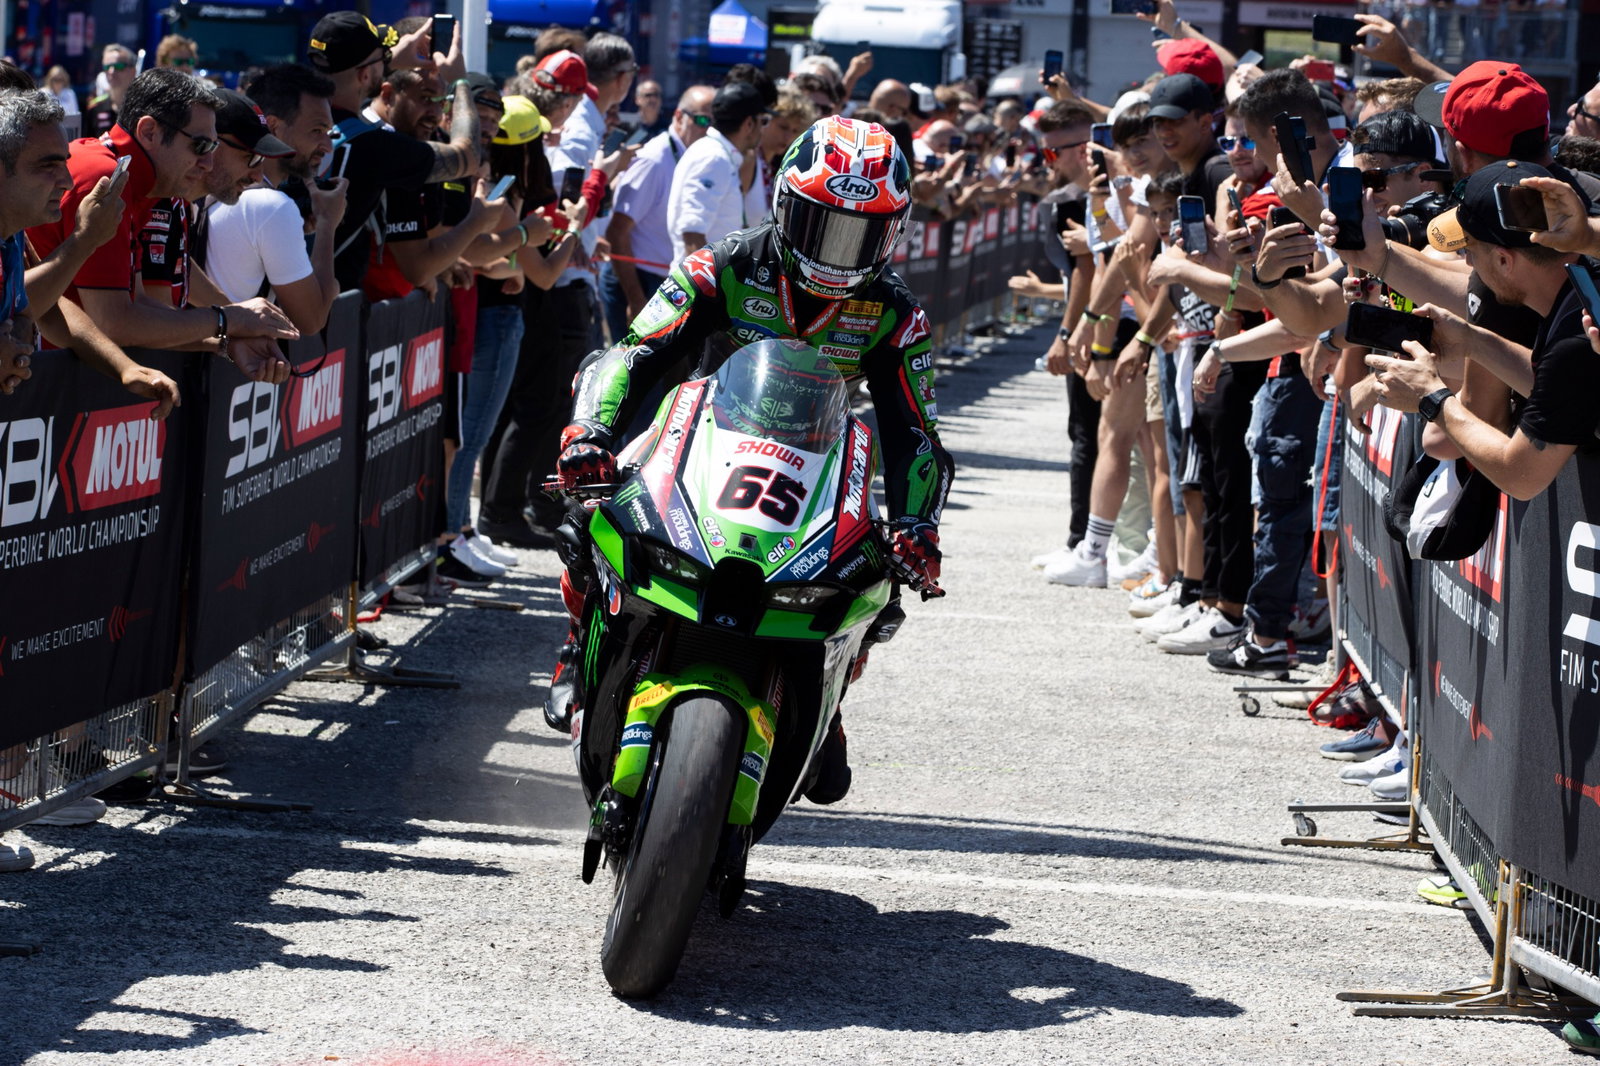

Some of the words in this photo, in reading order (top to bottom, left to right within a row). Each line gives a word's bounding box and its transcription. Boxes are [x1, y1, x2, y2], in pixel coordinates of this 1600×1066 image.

[830, 177, 873, 196] Arai
[792, 247, 873, 276] www.jonathan-rea.com
[744, 277, 776, 294] Kawasaki
[805, 279, 847, 295] Medallia
[745, 300, 774, 316] Arai
[737, 327, 763, 341] elf
[821, 346, 859, 359] SHOWA
[911, 353, 932, 371] elf
[297, 361, 343, 433] MOTUL
[85, 417, 163, 495] MOTUL
[734, 440, 805, 472] SHOWA
[222, 485, 235, 516] FIM
[236, 468, 273, 509] SUPERBIKE
[273, 458, 297, 491] WORLD
[297, 437, 342, 478] CHAMPIONSHIP
[716, 465, 808, 527] 65
[669, 509, 694, 550] mouldings
[702, 516, 721, 537] elf
[48, 524, 87, 560] WORLD
[767, 543, 786, 564] elf
[724, 548, 764, 563] Kawasaki
[793, 547, 830, 579] mouldings
[836, 554, 868, 580] MONSTER
[11, 640, 24, 661] WE
[26, 633, 51, 656] MAKE
[53, 617, 105, 649] EXCITEMENT
[1560, 649, 1585, 690] FIM
[634, 688, 664, 708] PIRELLI
